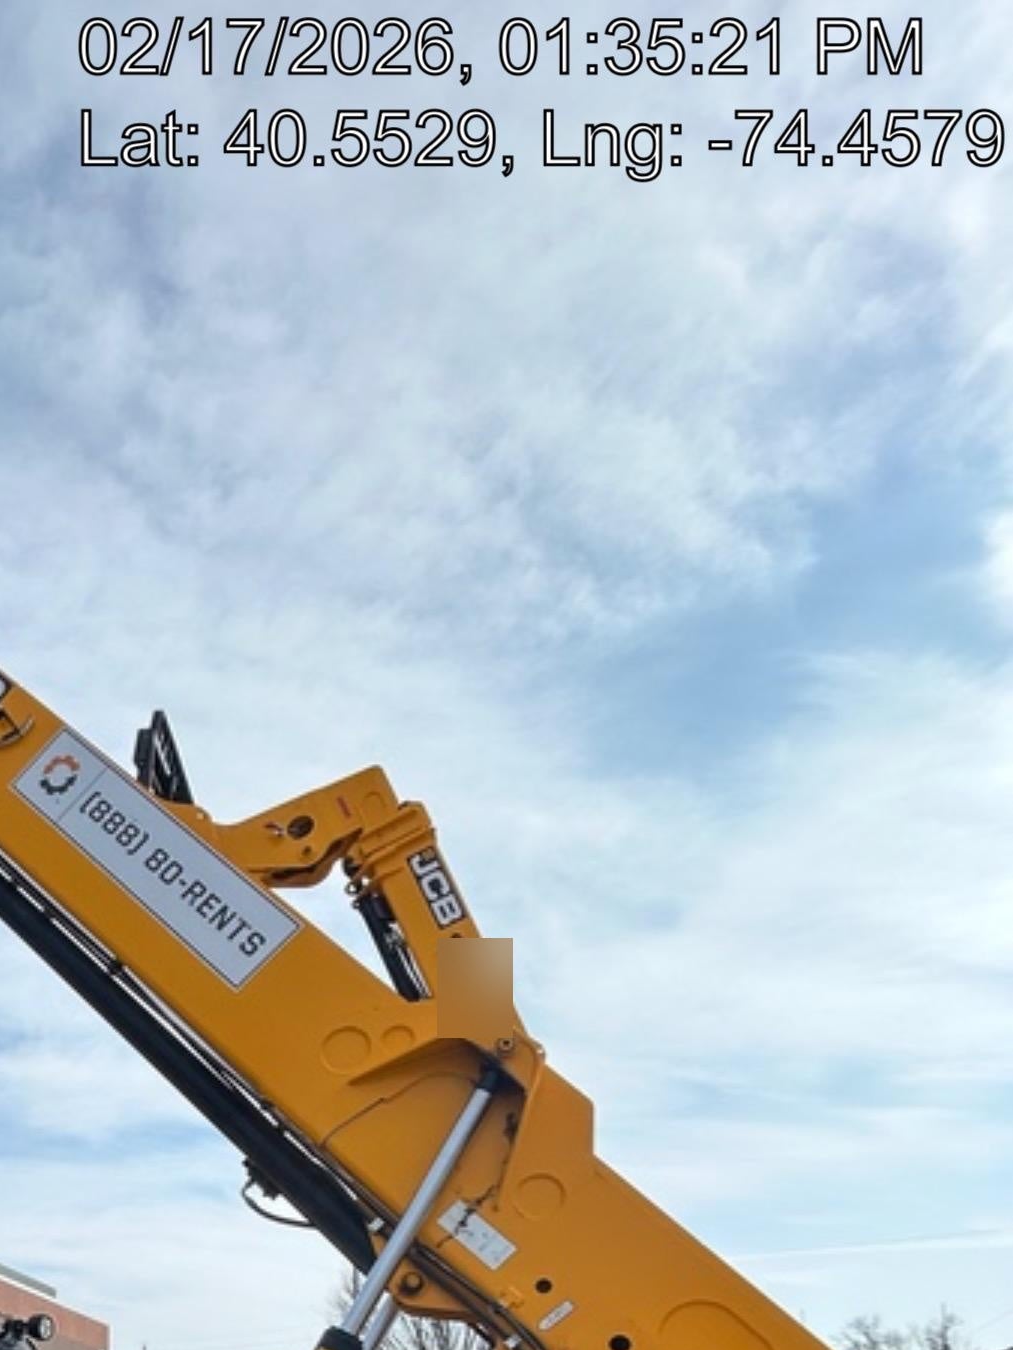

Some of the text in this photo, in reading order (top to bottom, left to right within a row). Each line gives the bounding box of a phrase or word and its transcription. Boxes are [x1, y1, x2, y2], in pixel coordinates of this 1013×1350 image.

[79, 791, 267, 957] (888) 80-RENTS
[409, 853, 463, 926] JCB
